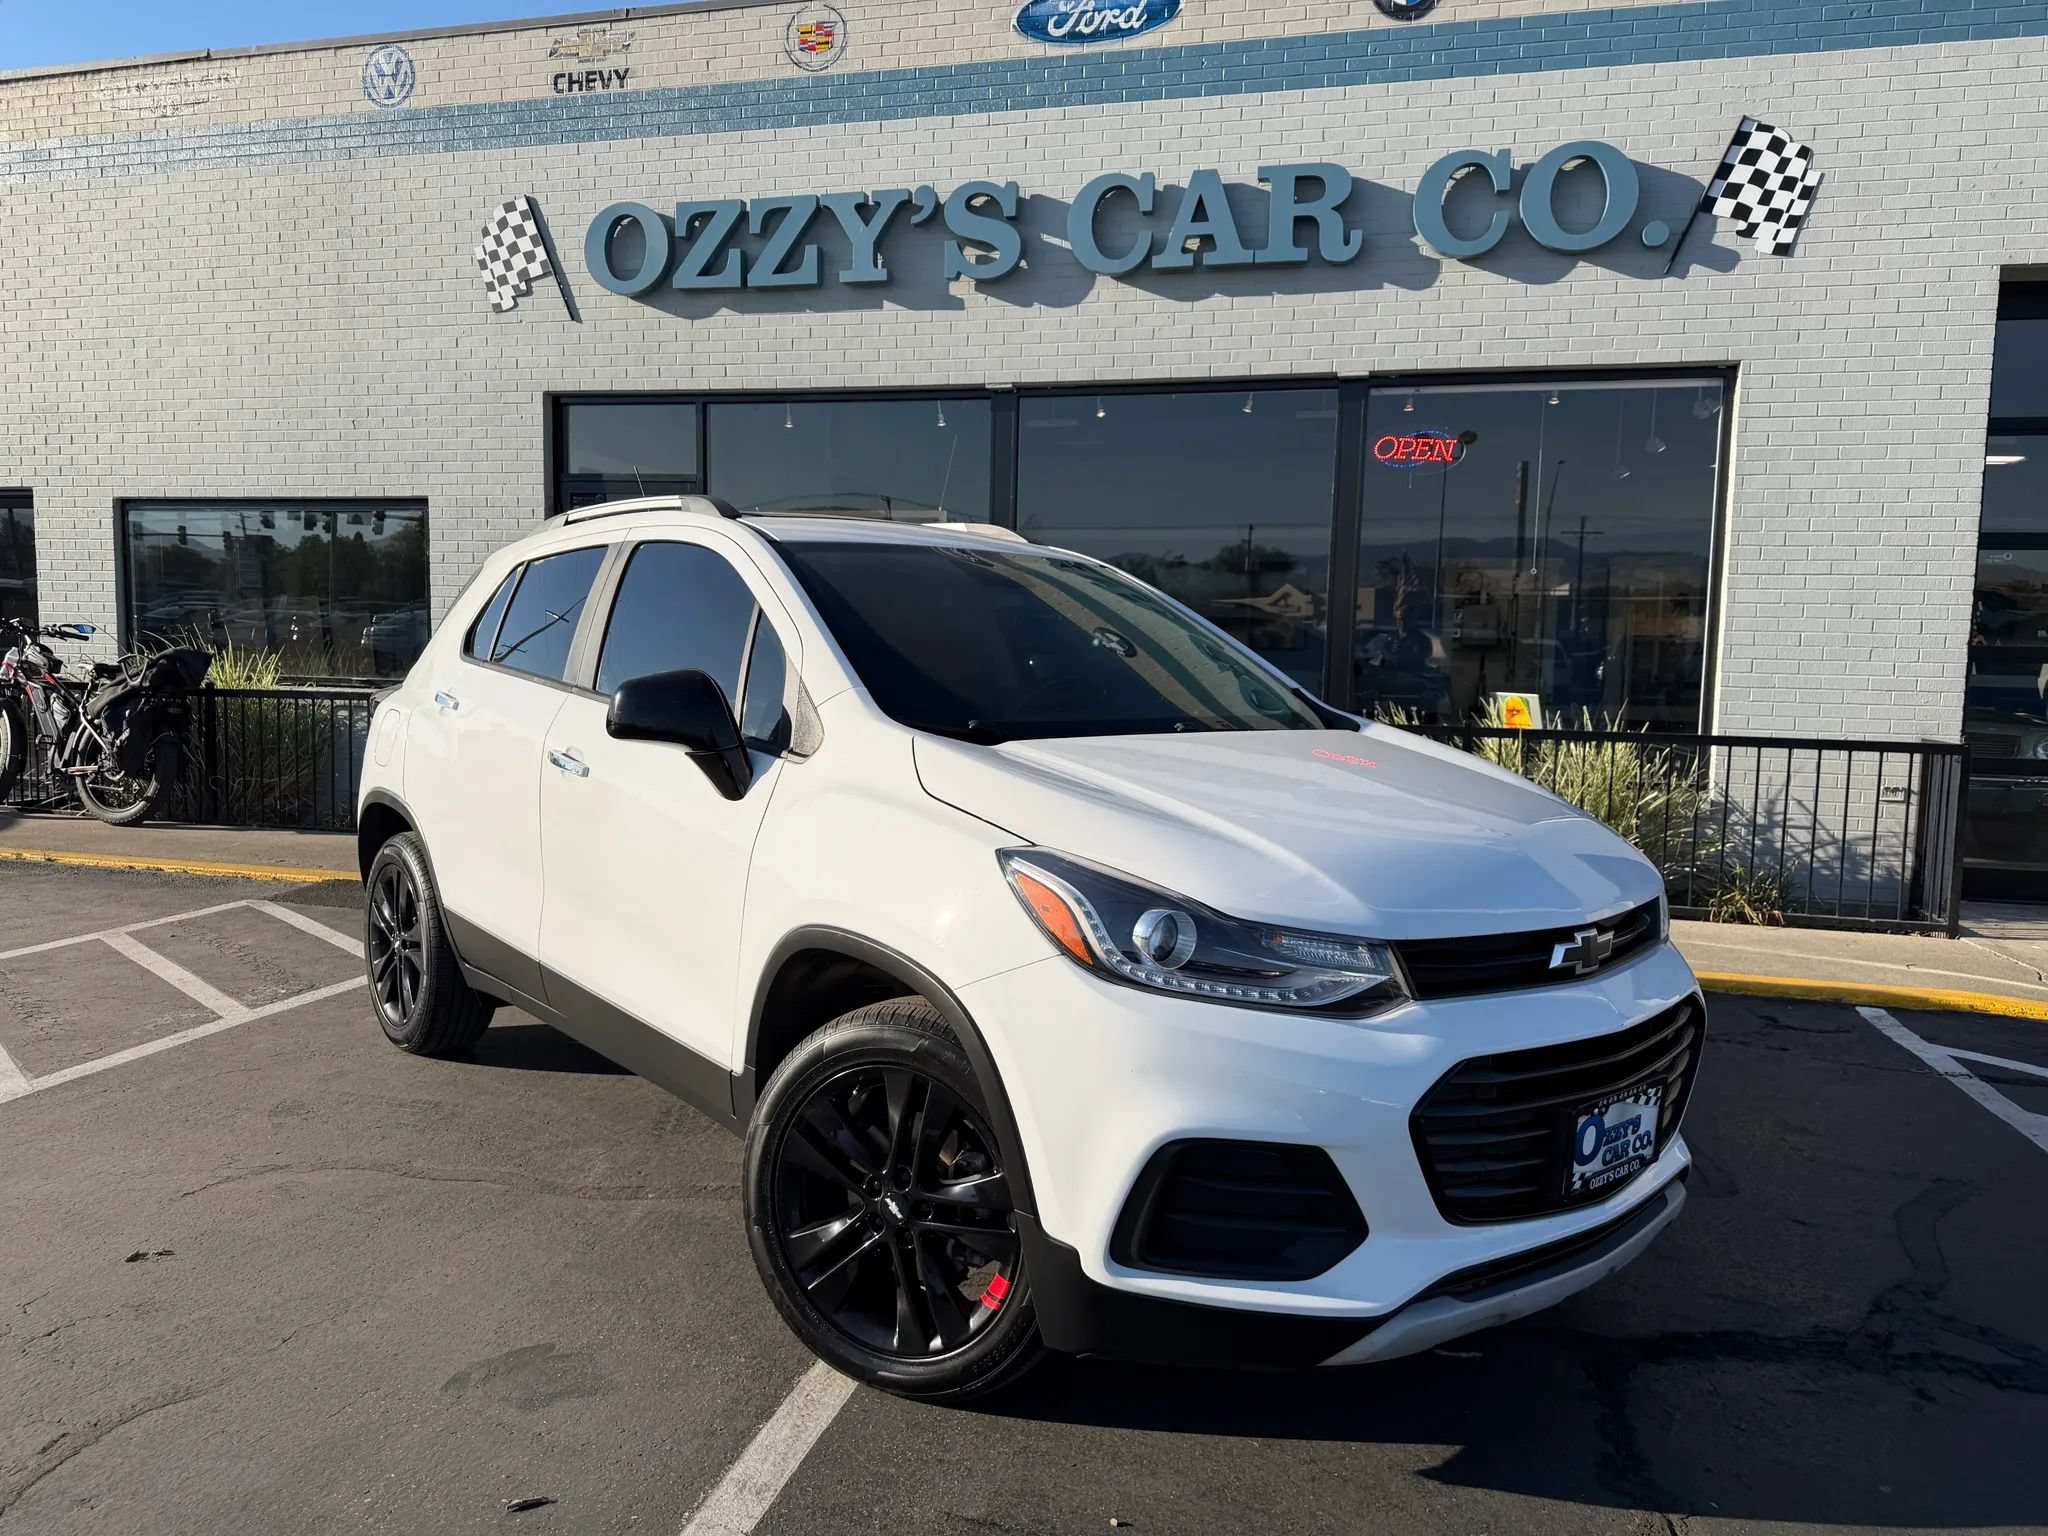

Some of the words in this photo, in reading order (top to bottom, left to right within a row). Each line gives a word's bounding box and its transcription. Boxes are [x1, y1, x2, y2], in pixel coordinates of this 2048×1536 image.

[1047, 0, 1148, 36] Ford
[553, 68, 630, 94] CHEVY
[584, 180, 1025, 298] OZZY'S
[1066, 162, 1364, 278] CAR
[1412, 140, 1670, 260] CO.
[1373, 435, 1458, 463] OPEN
[1602, 1140, 1631, 1166] CAR
[1632, 1130, 1652, 1154] CO.
[1615, 1163, 1629, 1178] CAR
[1630, 1159, 1641, 1172] CO.
